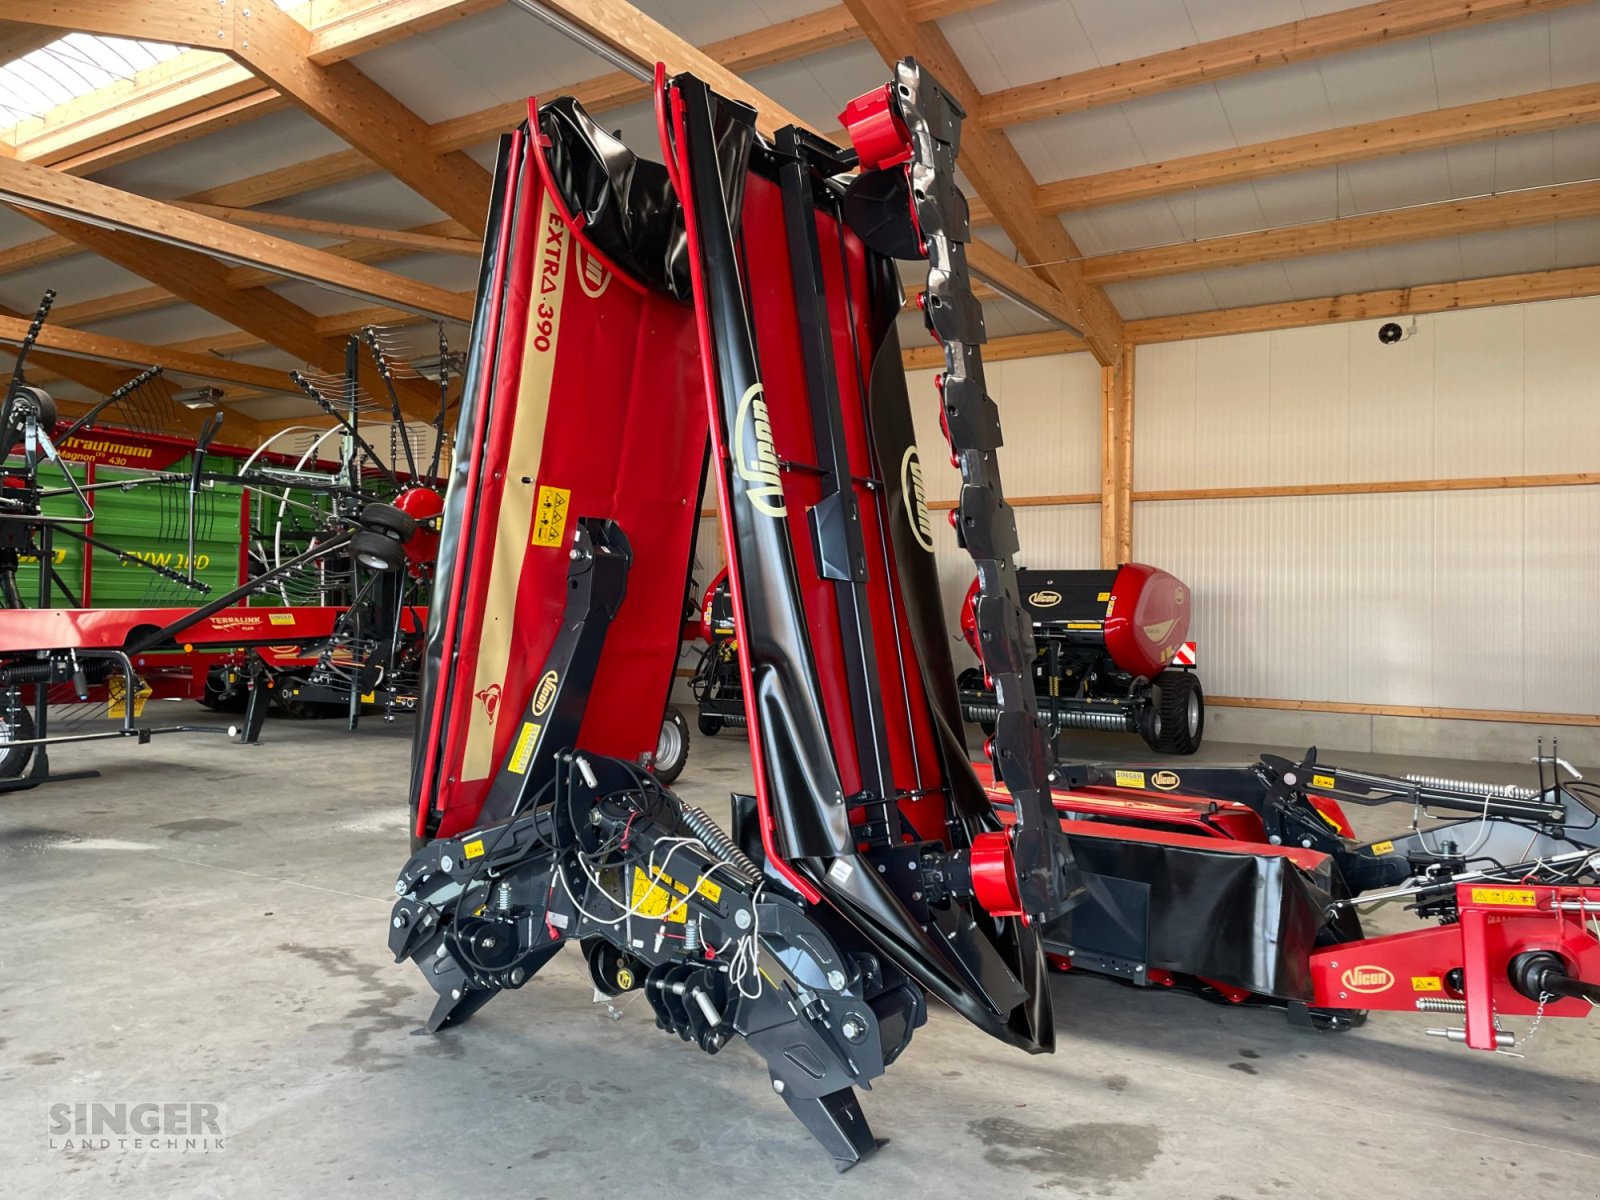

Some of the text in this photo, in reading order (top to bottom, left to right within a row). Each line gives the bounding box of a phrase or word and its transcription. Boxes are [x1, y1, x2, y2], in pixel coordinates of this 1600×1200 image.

[534, 303, 554, 353] 390
[60, 436, 153, 458] trautmann
[108, 456, 127, 466] 430
[1032, 591, 1059, 604] Vicon
[534, 674, 555, 713] Vicon
[1116, 771, 1143, 780] SINGER
[1153, 771, 1177, 786] Vicon
[1345, 968, 1389, 988] Vicon
